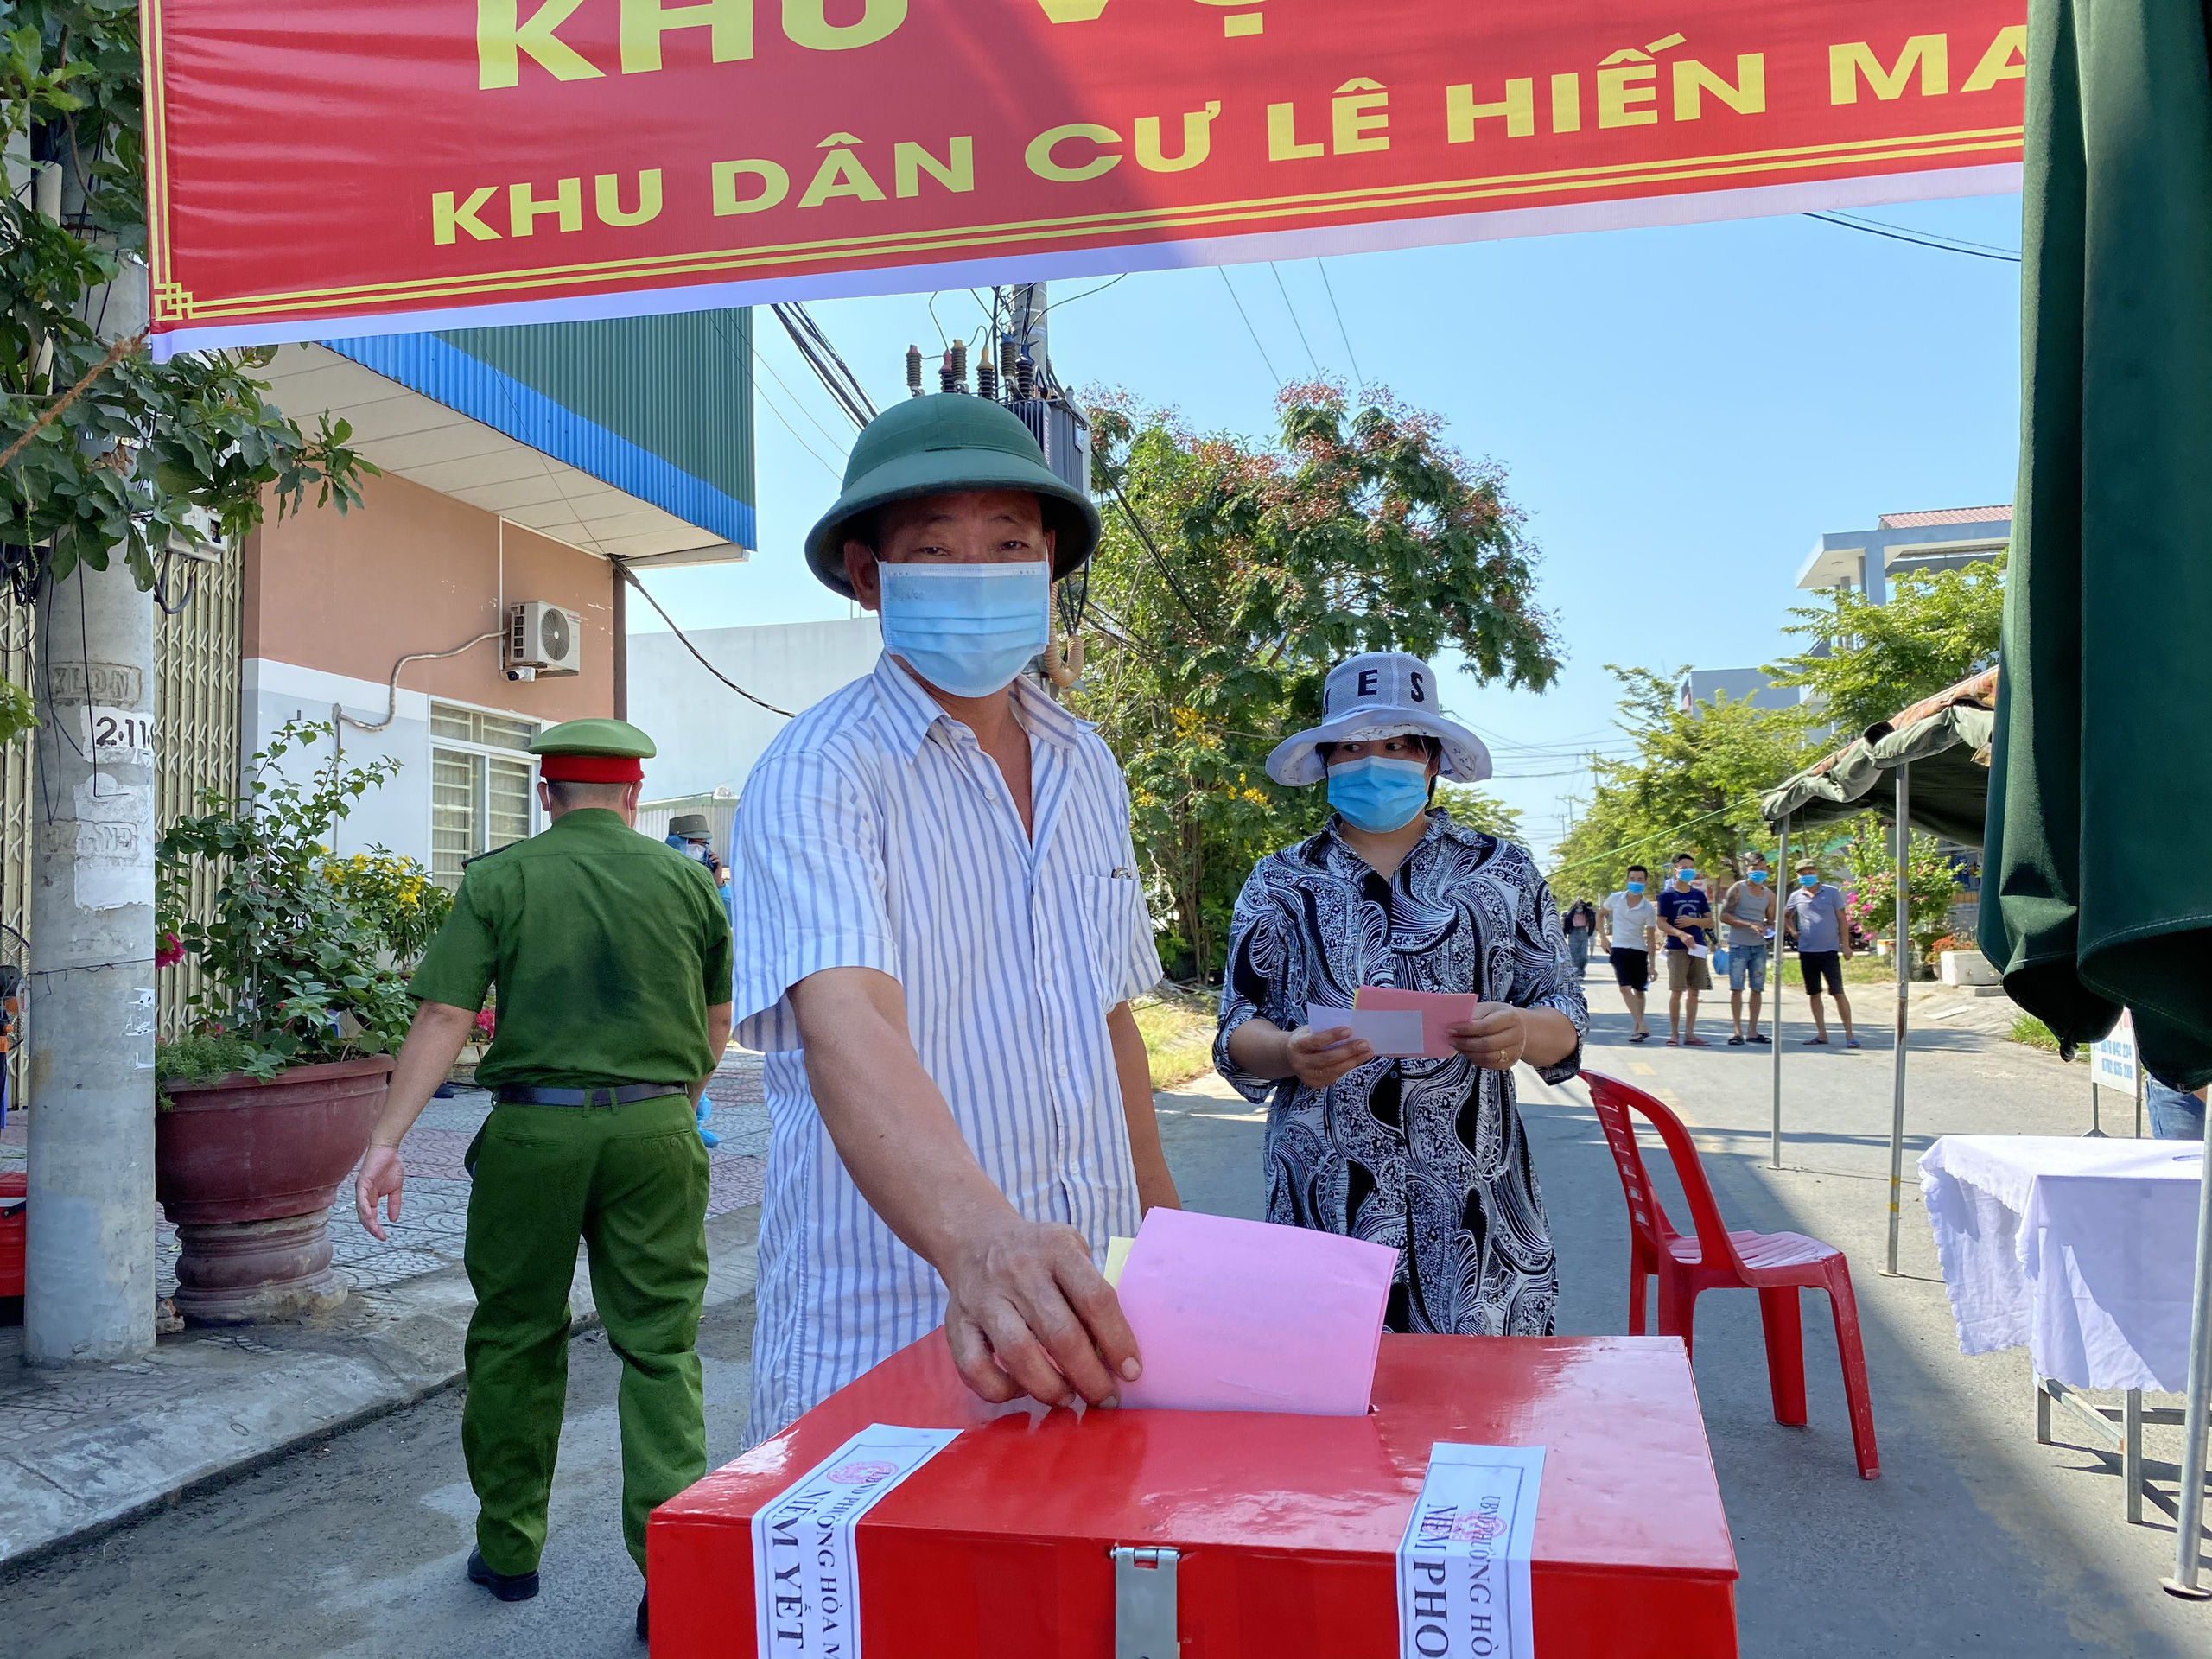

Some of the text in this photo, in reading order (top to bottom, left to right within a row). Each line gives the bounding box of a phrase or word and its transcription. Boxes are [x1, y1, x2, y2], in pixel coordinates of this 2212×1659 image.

[431, 168, 663, 245] KHU
[710, 131, 975, 217] DÂN
[1025, 100, 1221, 182] CƯ
[1267, 77, 1390, 162] LÊ
[1446, 32, 1767, 144] HIẾN
[772, 1489, 833, 1649] NIÊM YẾT
[816, 1497, 861, 1568] PHƯỜNG
[820, 1577, 843, 1633] HÒA
[1414, 1558, 1452, 1659] PHO
[1471, 1613, 1500, 1659] HÒ
